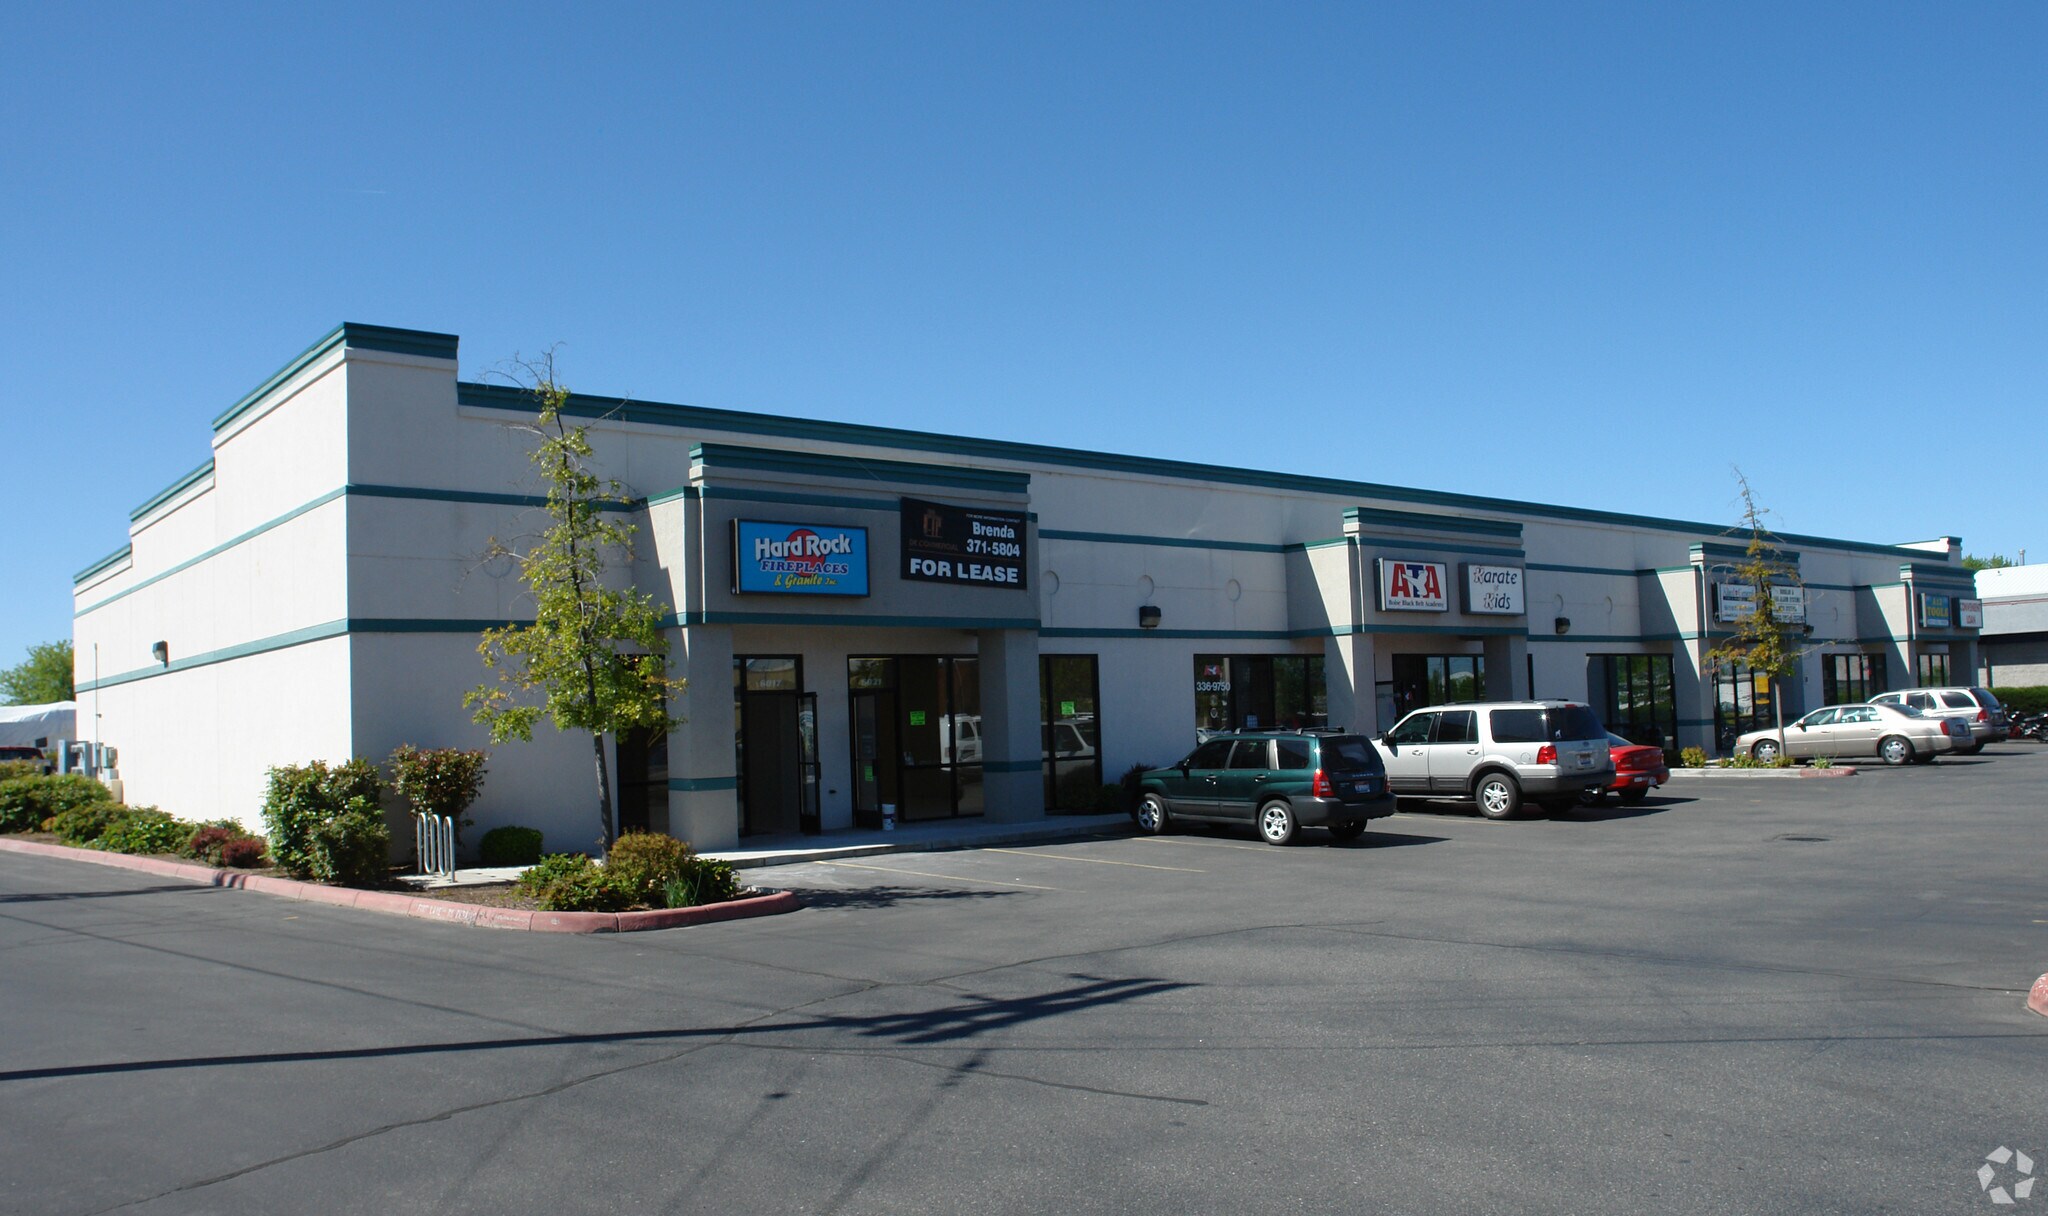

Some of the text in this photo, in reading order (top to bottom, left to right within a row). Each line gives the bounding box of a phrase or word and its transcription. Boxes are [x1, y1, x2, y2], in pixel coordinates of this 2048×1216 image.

[972, 521, 1015, 538] Brenda
[755, 533, 852, 561] Hard Rock
[966, 538, 1020, 557] 371-5804
[761, 560, 849, 575] FIREPLACES
[910, 557, 1018, 583] FOR LEASE
[1473, 567, 1517, 584] Karate
[774, 573, 782, 586] &
[785, 574, 823, 589] Granite
[1391, 563, 1442, 599] ATA
[1483, 592, 1511, 610] Kids
[1196, 681, 1231, 692] 336-9750
